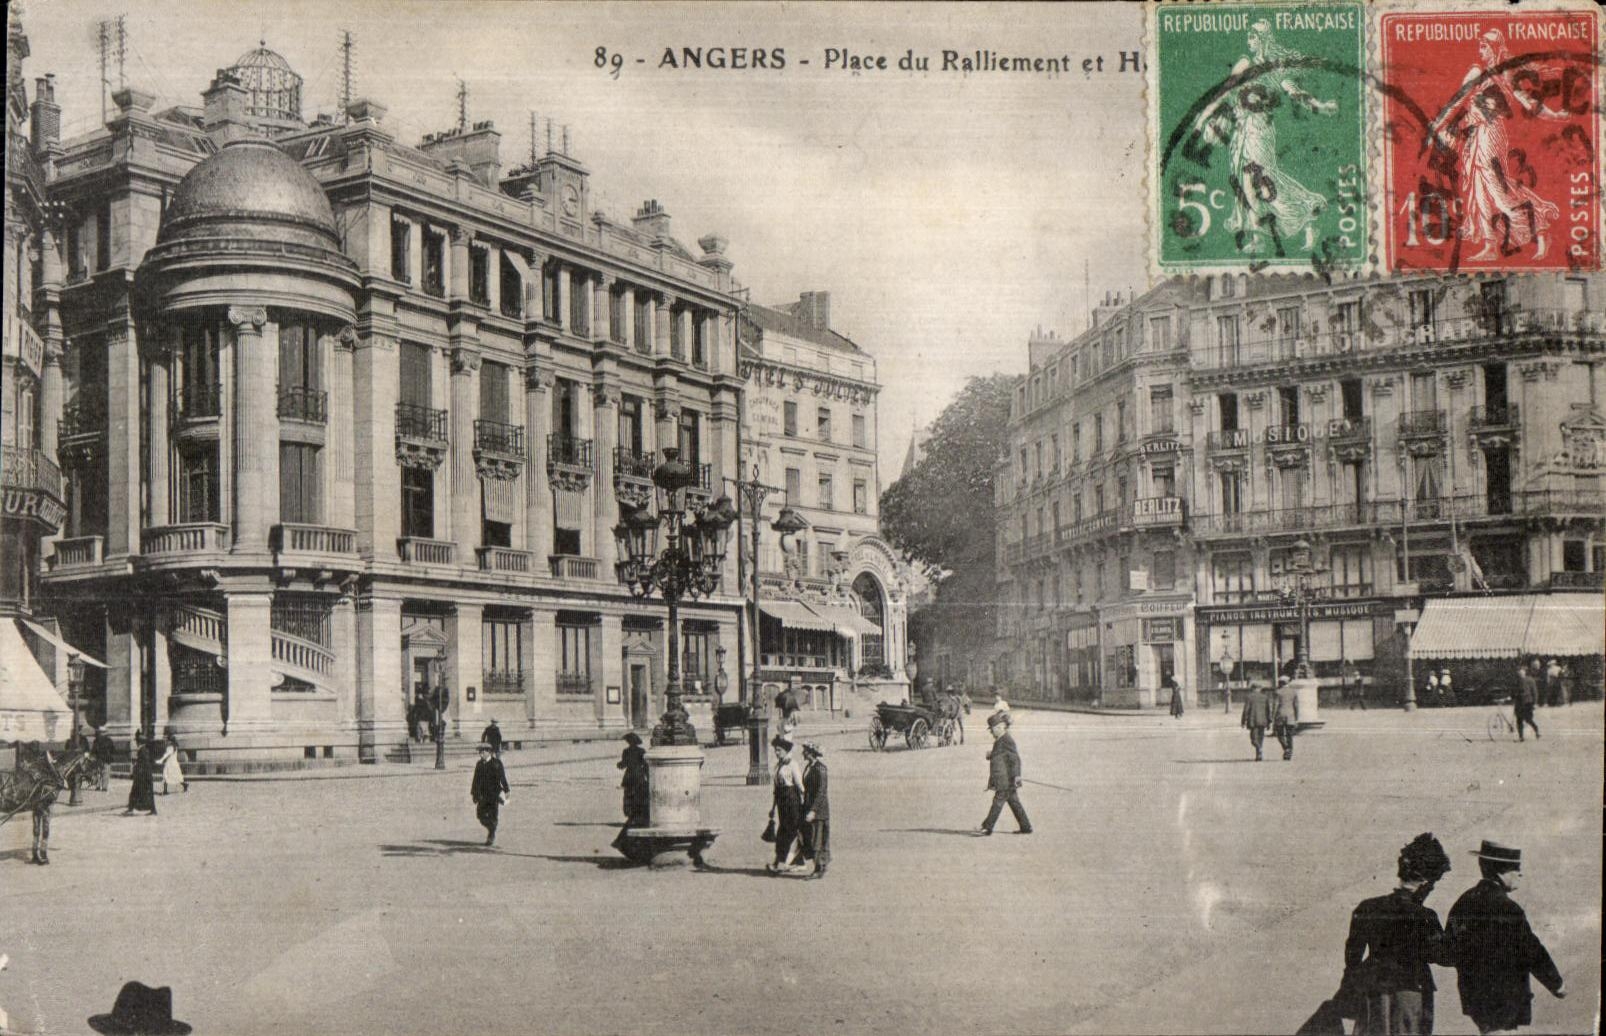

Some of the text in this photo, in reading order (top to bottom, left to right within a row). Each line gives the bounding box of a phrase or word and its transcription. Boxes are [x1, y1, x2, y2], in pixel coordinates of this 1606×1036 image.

[1164, 12, 1356, 34] REPUBLIQUE FRANÇAISE
[1396, 22, 1588, 42] REPUBLIQUE FRANÇAISE
[1338, 163, 1358, 248] POSTES
[1570, 171, 1590, 257] POSTES
[1139, 441, 1181, 453] BERLITZ
[1134, 498, 1181, 515] BERLITZ
[1250, 607, 1320, 620] INSTRUMETS
[1325, 605, 1370, 617] MUSIQUE
